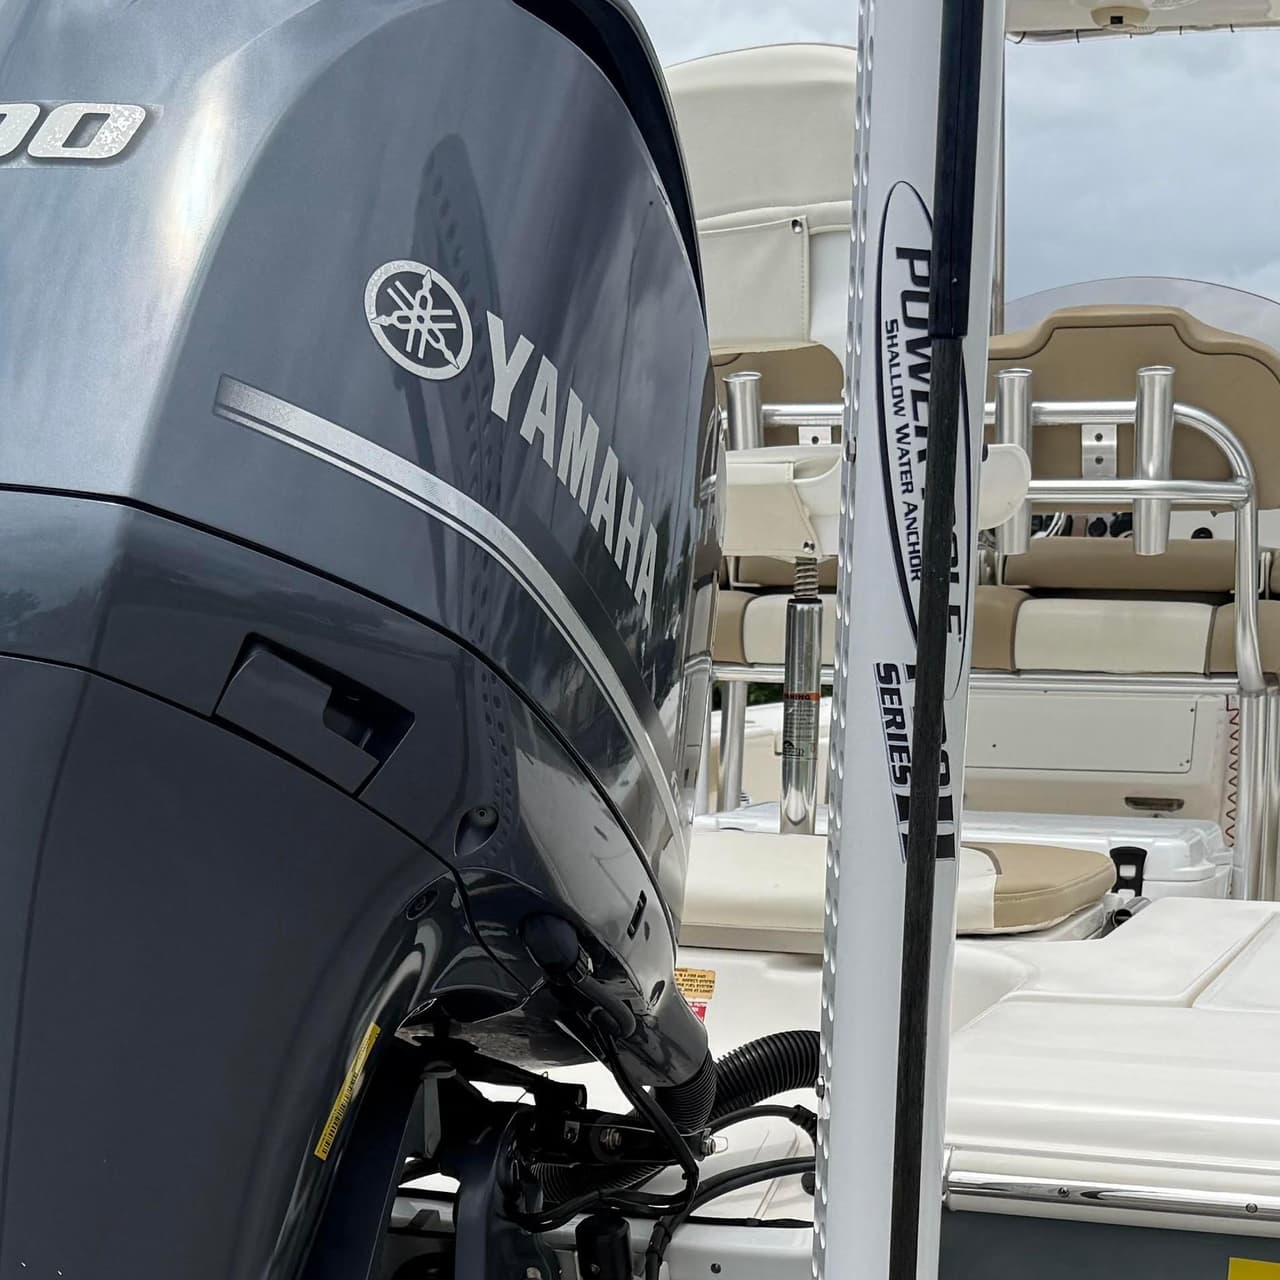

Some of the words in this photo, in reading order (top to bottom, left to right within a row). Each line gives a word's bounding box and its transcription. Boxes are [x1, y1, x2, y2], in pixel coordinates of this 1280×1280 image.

[885, 318, 907, 417] SHALLOW
[486, 310, 658, 630] YAMAHA
[894, 422, 914, 495] WATER
[902, 500, 922, 582] ANCHOR
[874, 661, 912, 786] SERIES
